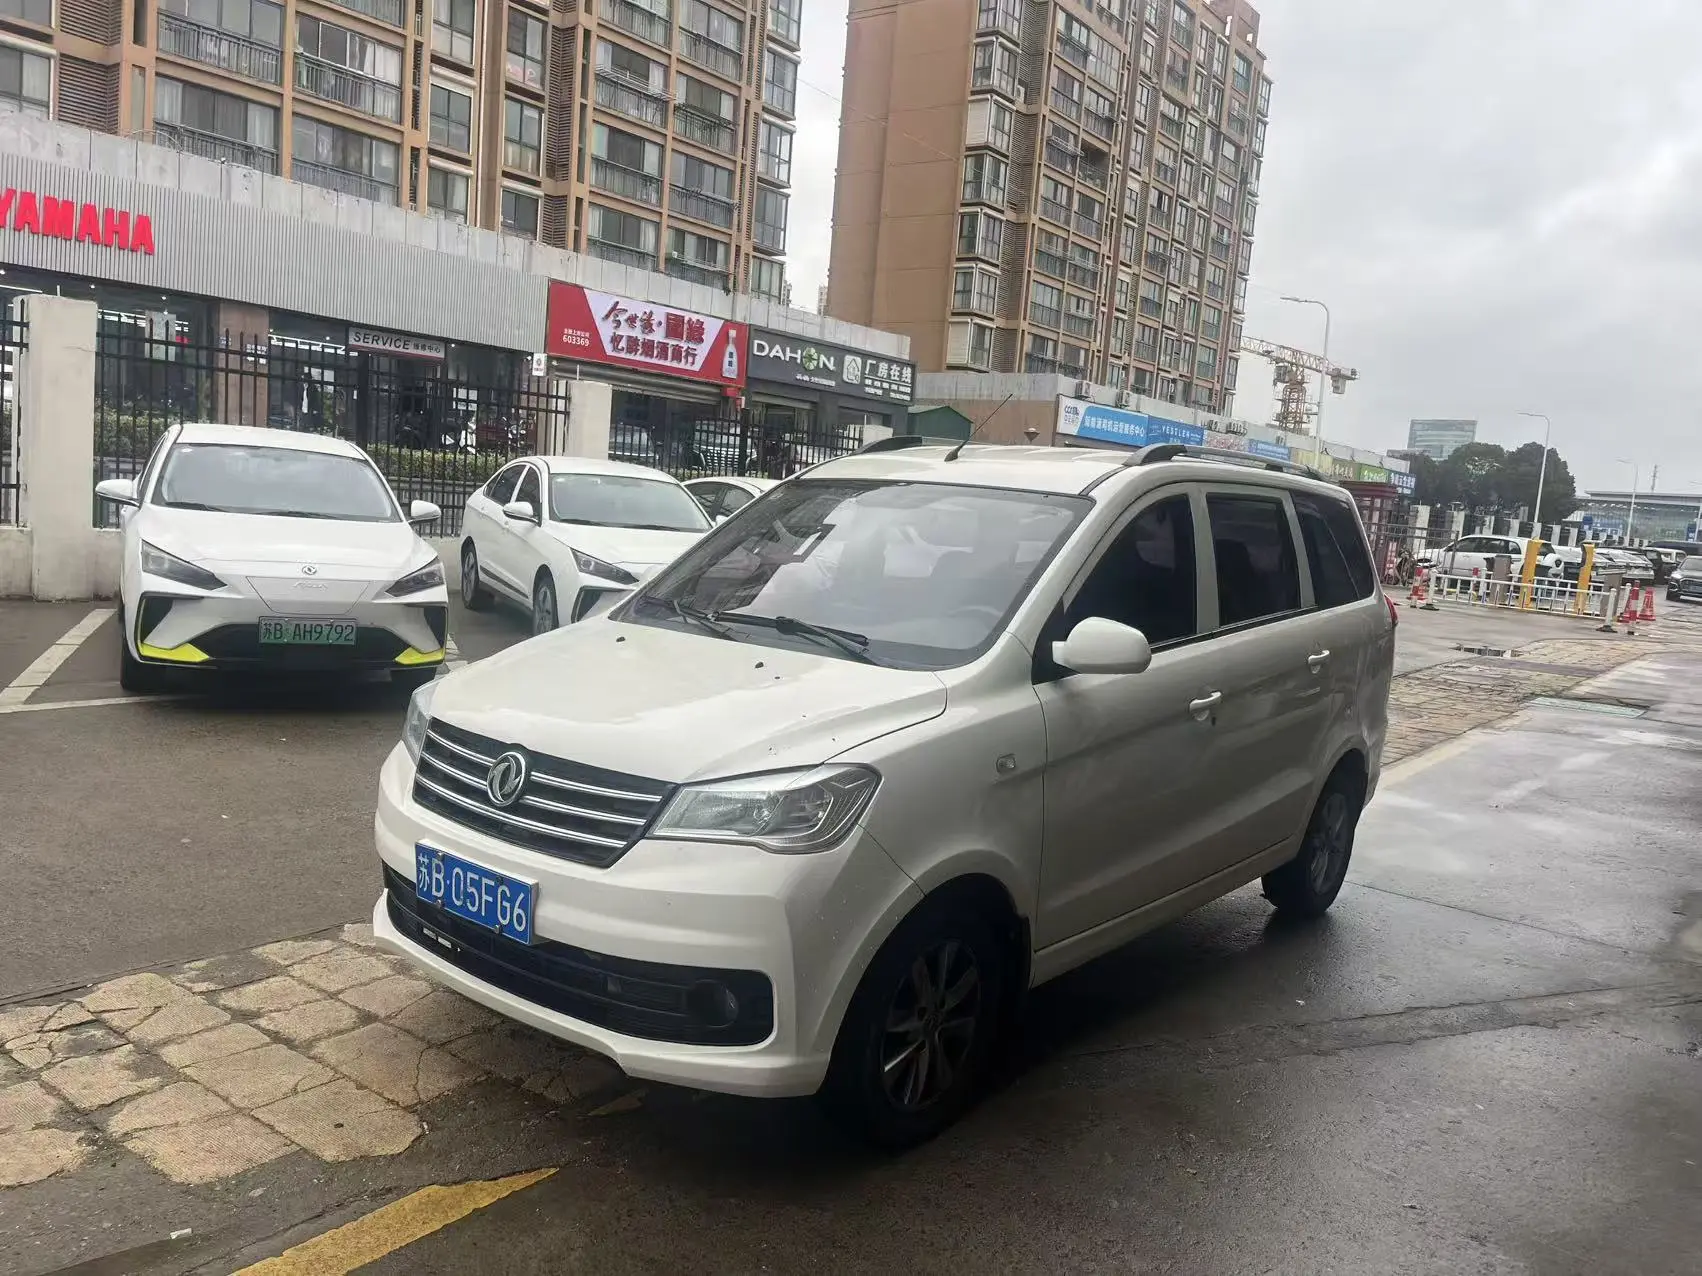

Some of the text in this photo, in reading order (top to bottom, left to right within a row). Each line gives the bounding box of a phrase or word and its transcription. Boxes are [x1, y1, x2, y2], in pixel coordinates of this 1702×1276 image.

[0, 188, 155, 255] YAMAHA
[353, 331, 411, 350] SERVICE
[562, 335, 590, 347] 603369
[864, 359, 912, 384] 厂房在线
